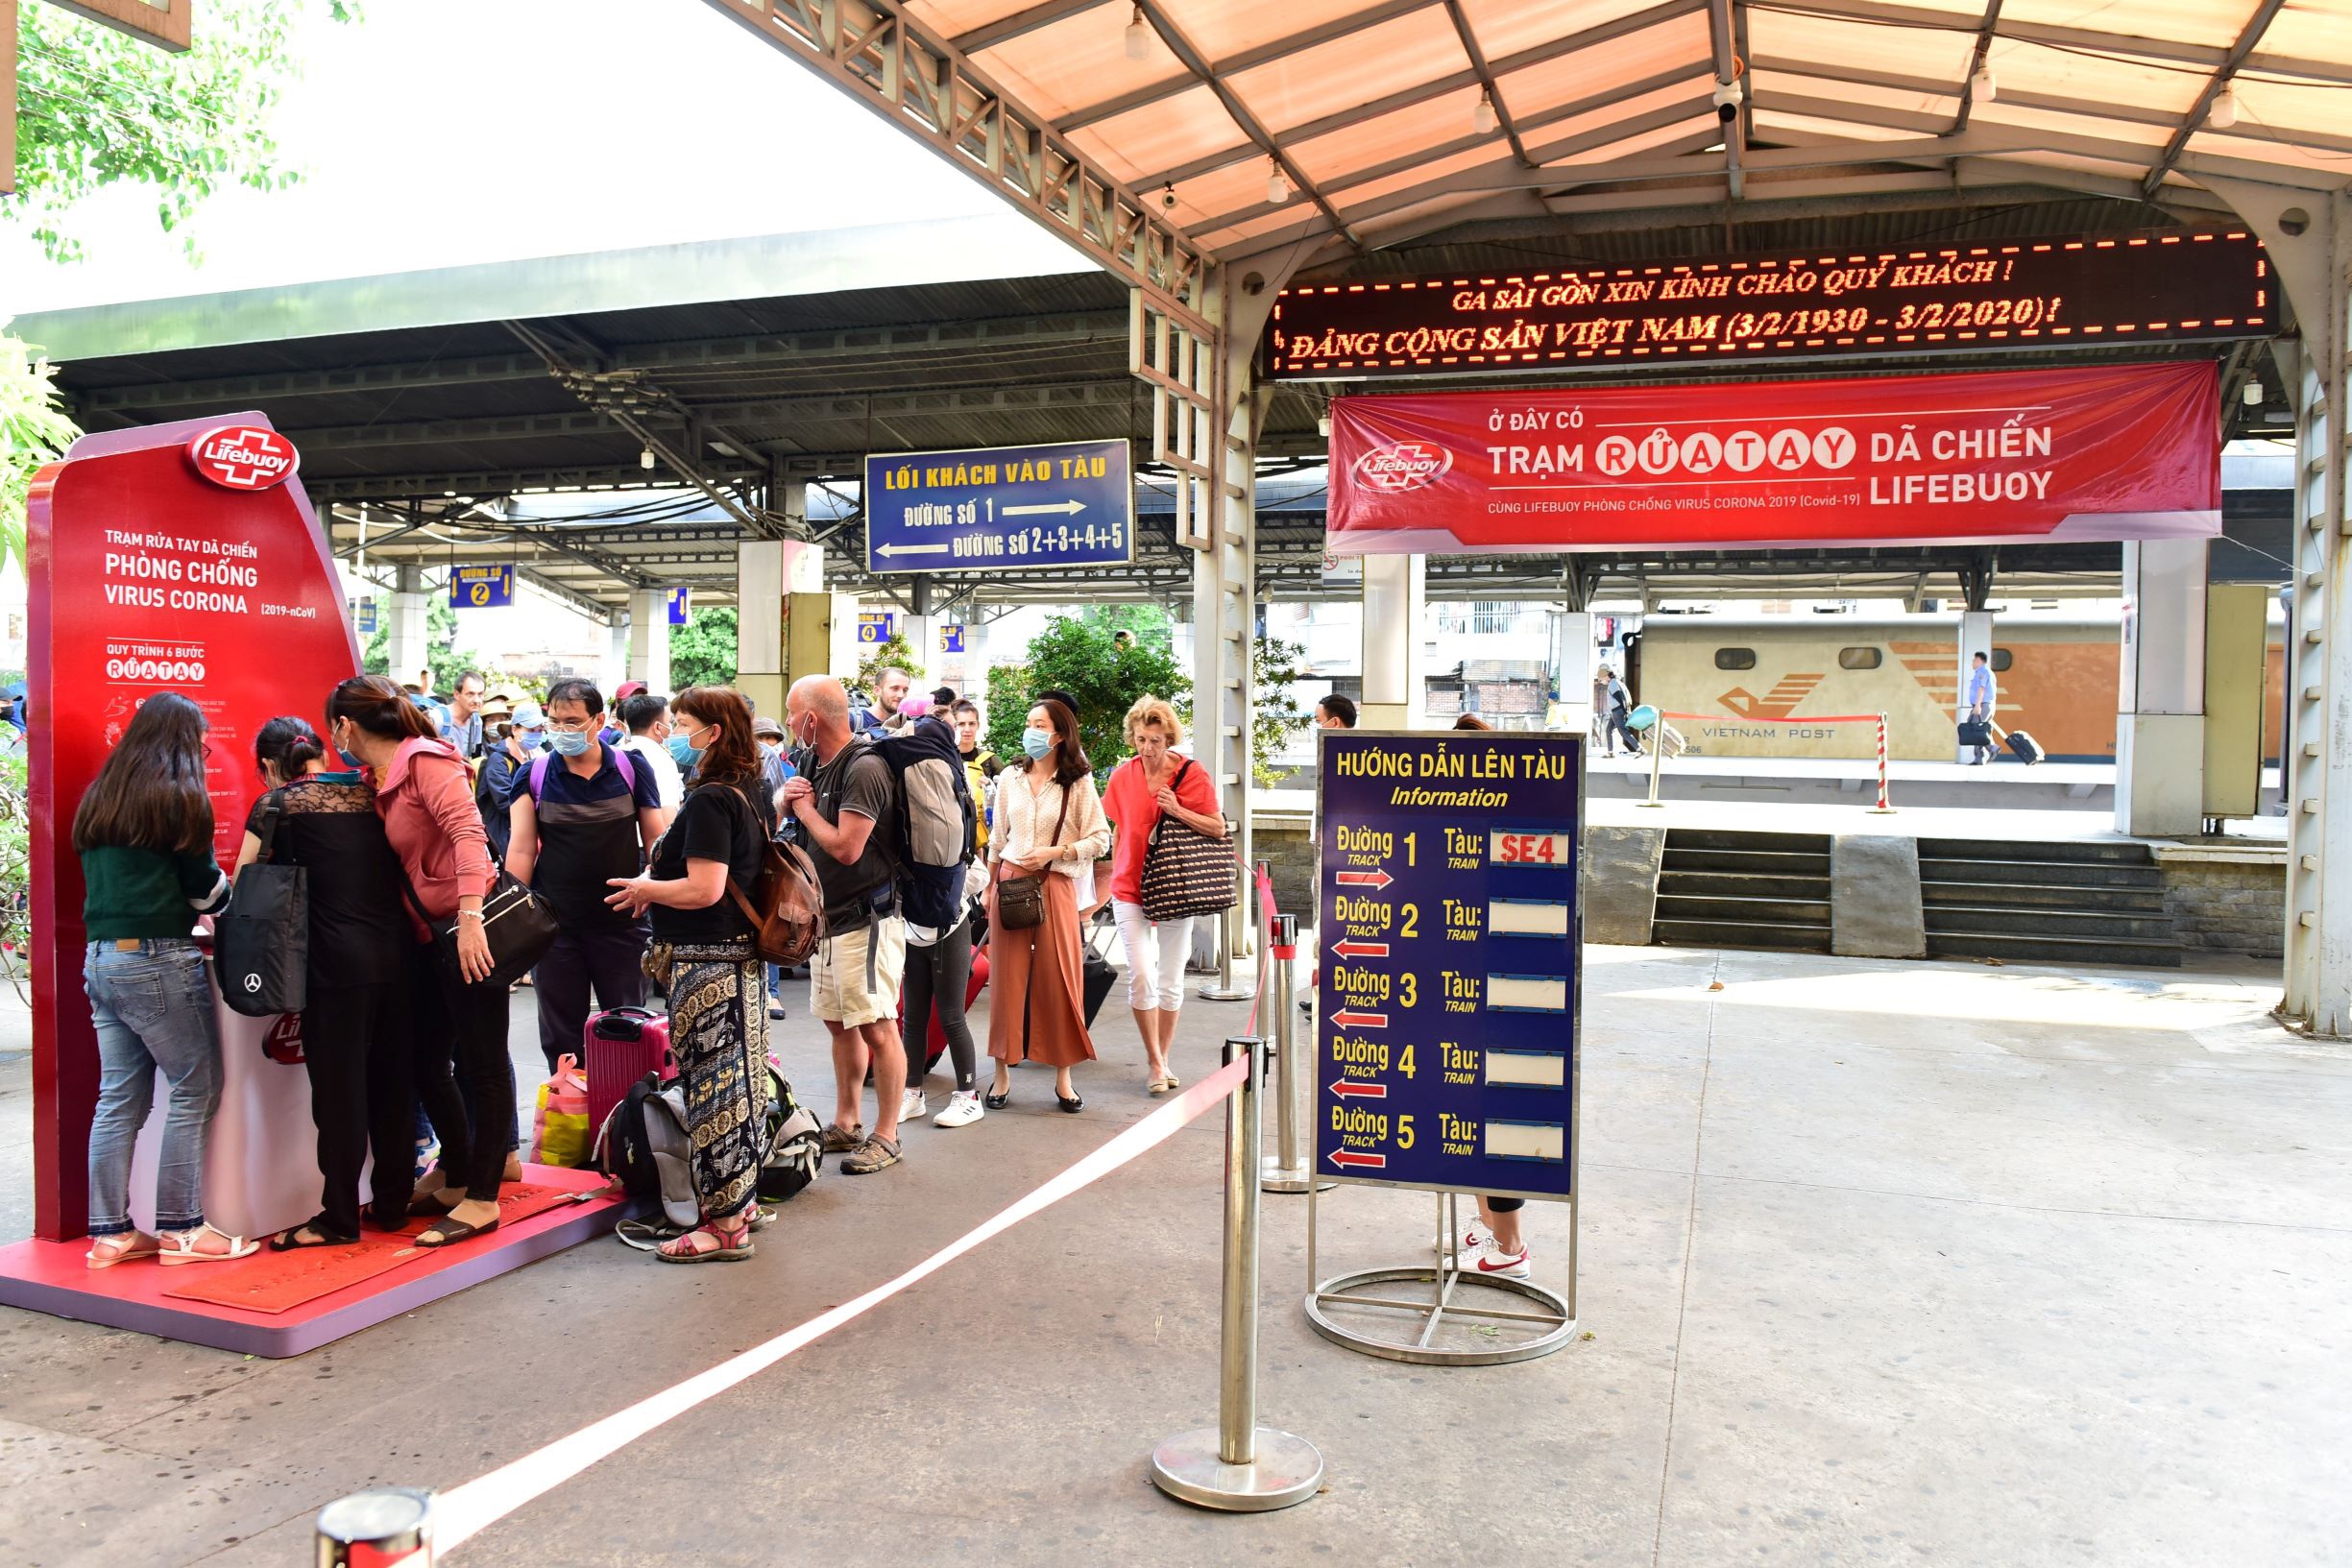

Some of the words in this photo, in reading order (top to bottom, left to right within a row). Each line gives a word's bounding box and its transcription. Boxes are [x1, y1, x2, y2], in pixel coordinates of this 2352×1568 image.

[1452, 291, 1487, 311] GA
[1492, 282, 1538, 309] SÀI
[1541, 278, 1601, 305] GÒN
[1603, 280, 1655, 303] XIN
[1659, 271, 1732, 300] KÍNH
[1737, 266, 1817, 296] CHÀO
[1824, 260, 1888, 296] QUÝ
[1890, 255, 1997, 288] KHÁCH
[1289, 327, 1380, 358] ĐẢNG
[1385, 326, 1477, 358] CỘNG
[1480, 319, 1549, 351] SẢN
[1556, 317, 1634, 350] VIỆT
[1637, 315, 1721, 342] NAM
[1726, 306, 1868, 343] (3/2/1930
[1488, 407, 1505, 432] Ở
[1509, 408, 1548, 431] ĐÂY
[1556, 404, 1584, 429] CÓ
[205, 441, 290, 473] Lifebuoy
[1487, 444, 1584, 480] TRẠM
[1870, 423, 1921, 463] DÃ
[1931, 413, 2052, 461] CHIẾN
[885, 464, 919, 490] LỐI
[926, 462, 997, 488] KHÁCH
[1005, 458, 1052, 483] VÀO
[1059, 455, 1106, 479] TÀU
[1362, 457, 1443, 475] Lifebuoy
[1870, 470, 2053, 506] LIFEBUOY
[904, 501, 953, 527] ĐƯỜNG
[958, 497, 978, 524] SỐ
[984, 497, 994, 523] 1
[1489, 500, 1521, 514] CÙNG
[1524, 500, 1580, 514] LIFEBUOY
[1584, 497, 1626, 512] PHÒNG
[1629, 495, 1672, 511] CHỐNG
[1674, 497, 1710, 510] VIRUS
[1713, 496, 1766, 509] CORONA
[1769, 495, 1797, 508] 2019
[105, 529, 143, 548] TRẠM
[145, 531, 174, 549] RỬA
[176, 538, 199, 552] TAY
[202, 539, 220, 554] DÃ
[221, 541, 257, 559] CHIẾN
[953, 532, 1004, 557] ĐƯỜNG
[1008, 529, 1029, 555] SỐ
[1031, 522, 1123, 554] 2+3+4+5
[105, 550, 182, 581] PHÒNG
[187, 558, 257, 588] CHỐNG
[105, 584, 165, 608] VIRUS
[170, 590, 248, 615] CORONA
[107, 644, 129, 656] QUY
[131, 643, 164, 657] TRÌNH
[166, 648, 173, 658] 6
[175, 645, 205, 659] BƯỚC
[1702, 728, 1776, 738] VIETNAM
[1789, 729, 1835, 738] POST
[1337, 746, 1413, 778] HƯỚNG
[1419, 742, 1465, 778] DẪN
[1471, 748, 1515, 779] LÊN
[1521, 749, 1566, 780] TÀU
[1390, 786, 1509, 808] Information
[1337, 825, 1393, 858] Đường
[1403, 832, 1417, 867] 1
[1443, 828, 1483, 855] Tàu:
[1500, 834, 1555, 863] SE4
[1347, 855, 1382, 866] TRACK
[1447, 857, 1479, 870] TRAIN
[1335, 896, 1392, 929] Đường
[1400, 904, 1418, 938] 2
[1443, 900, 1482, 927] Tàu:
[1346, 925, 1381, 937] TRACK
[1445, 929, 1478, 941] TRAIN
[1334, 966, 1390, 1001] Đường
[1399, 973, 1418, 1008] 3
[1441, 971, 1480, 999] Tàu:
[1345, 995, 1379, 1007] TRACK
[1444, 1001, 1476, 1013] TRAIN
[1333, 1035, 1389, 1071] Đường
[1397, 1044, 1417, 1079] 4
[1440, 1042, 1479, 1071] Tàu:
[1343, 1065, 1378, 1078] TRACK
[1443, 1072, 1475, 1085] TRAIN
[1331, 1105, 1388, 1141] Đường
[1396, 1114, 1416, 1149] 5
[1439, 1113, 1477, 1141] Tàu:
[1342, 1135, 1376, 1147] TRACK
[1442, 1143, 1474, 1156] TRAIN
